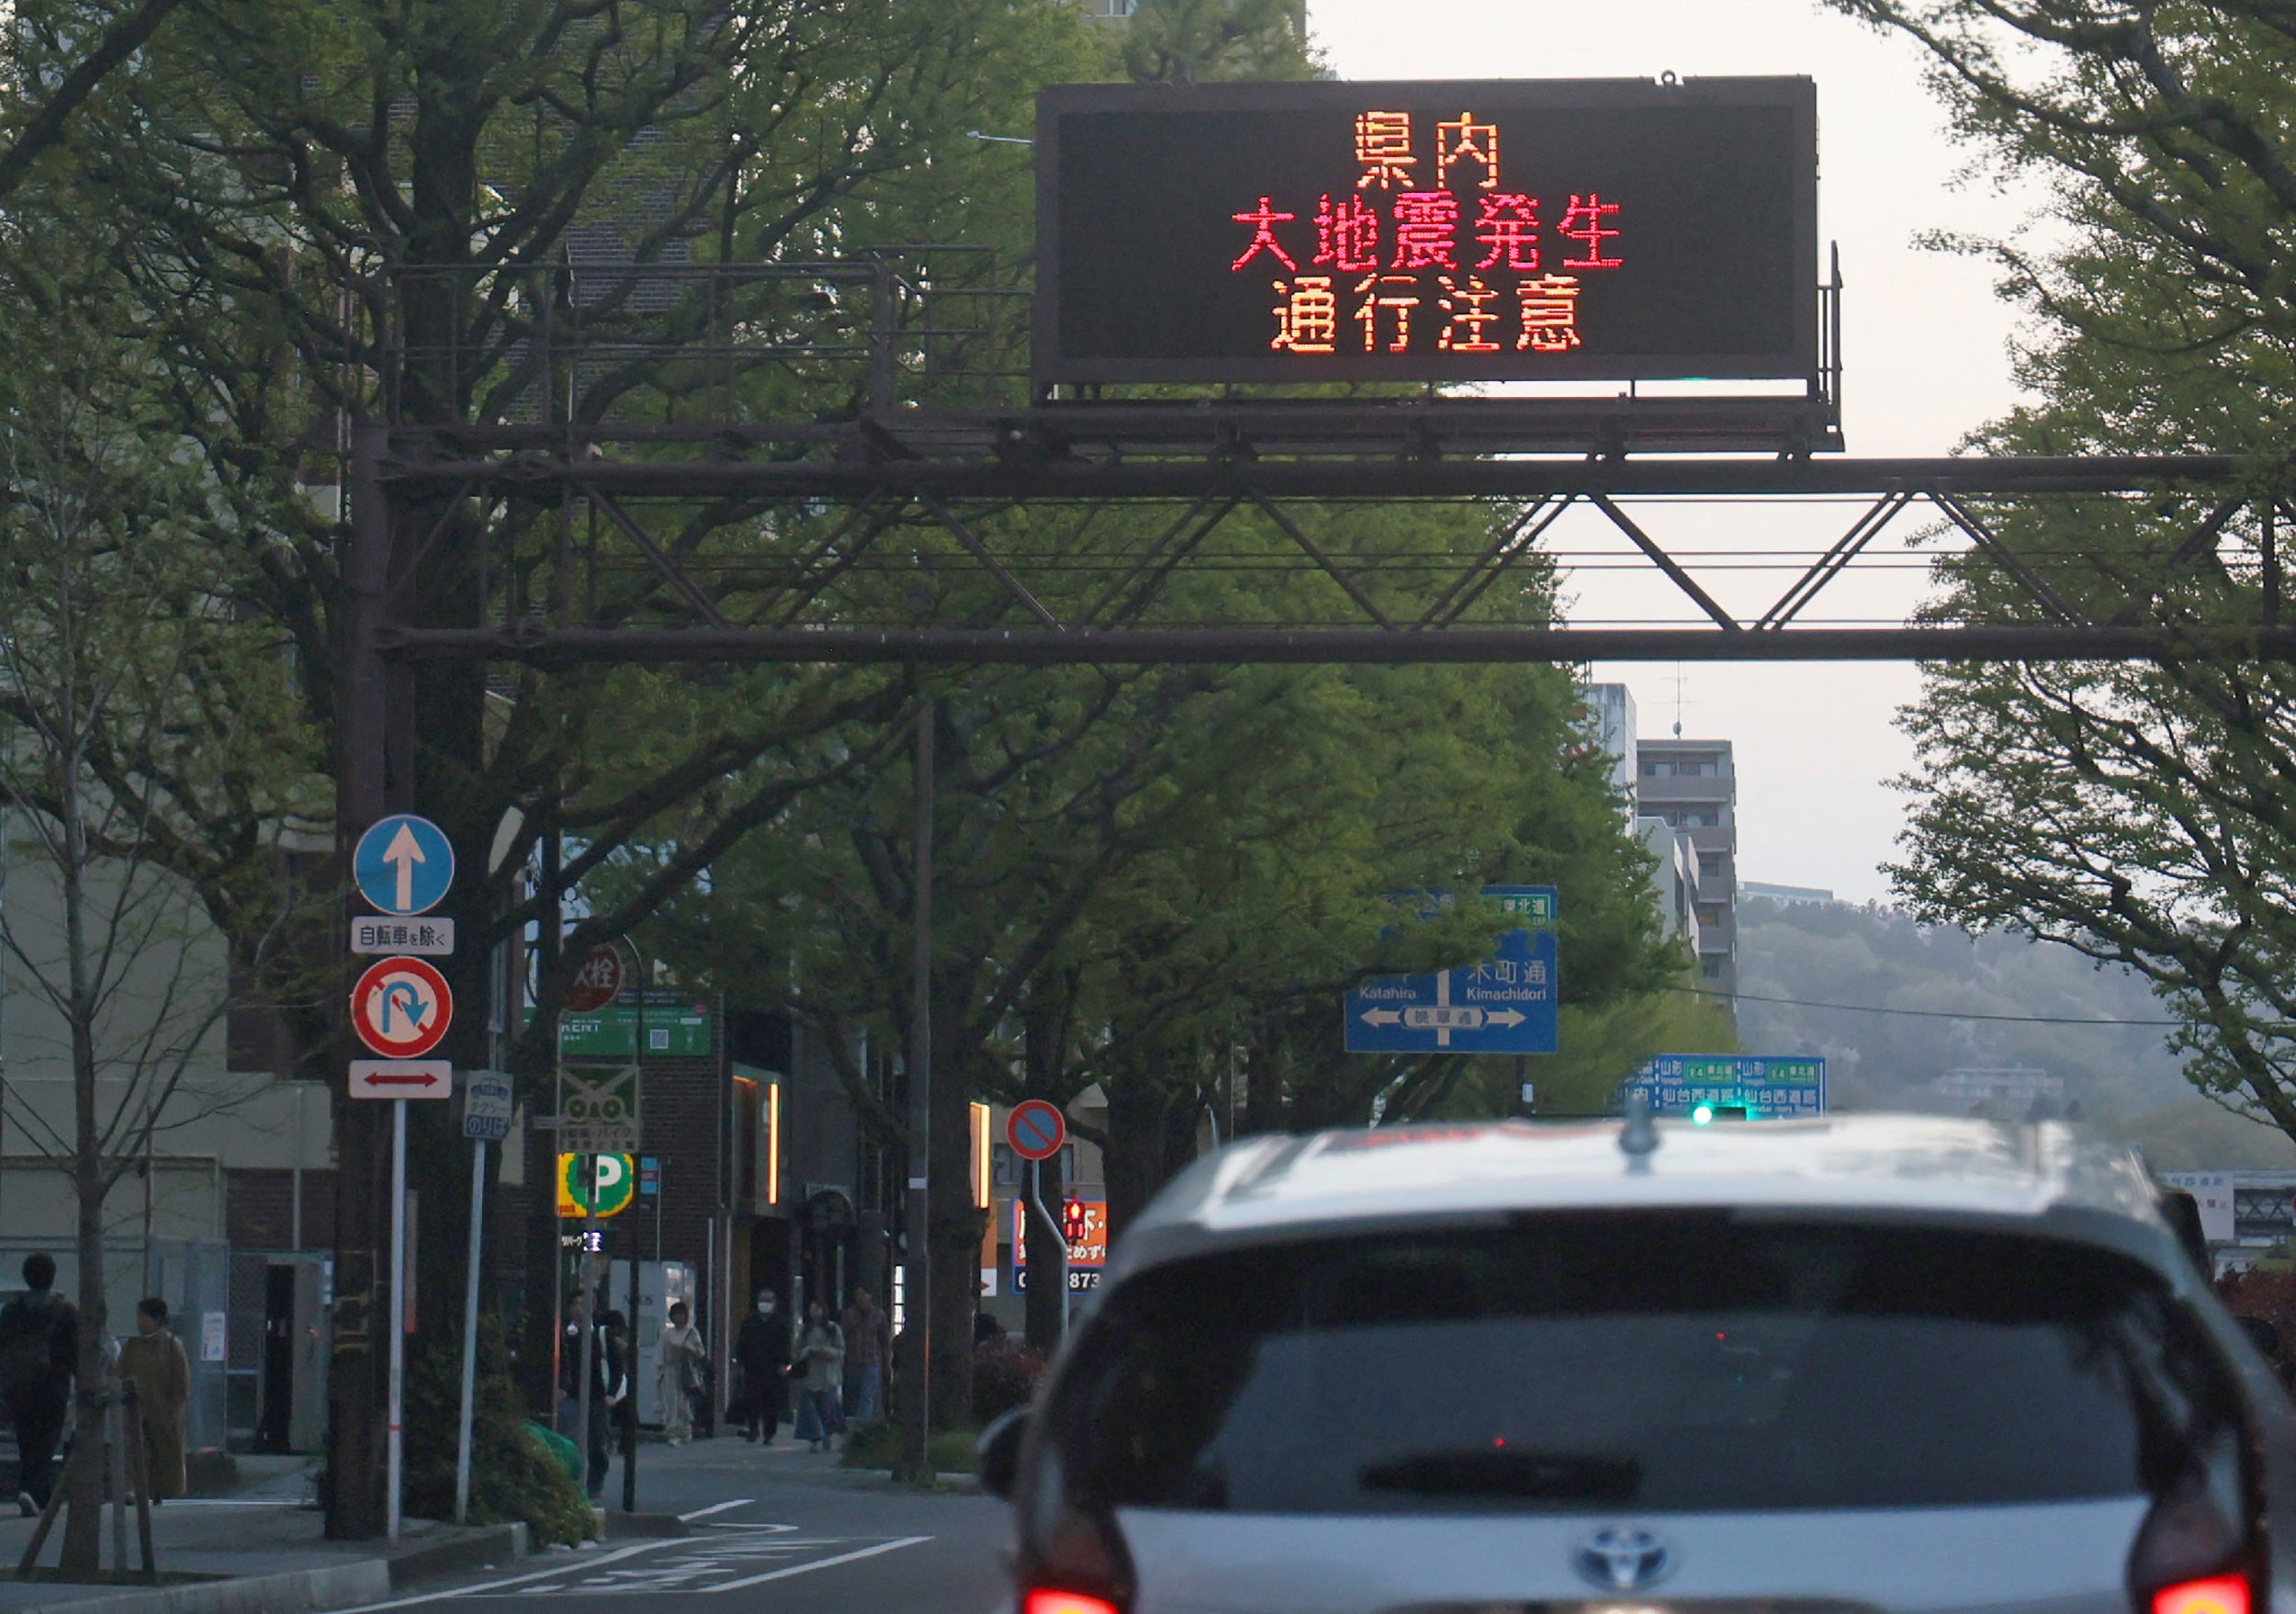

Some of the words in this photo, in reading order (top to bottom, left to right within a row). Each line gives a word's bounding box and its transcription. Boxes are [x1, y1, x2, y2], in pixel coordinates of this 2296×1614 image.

[1355, 110, 1500, 189] 県内
[1231, 190, 1625, 272] 大地震発生
[1271, 272, 1582, 353] 通行注意
[359, 924, 445, 947] 自転車を除く
[573, 957, 614, 988] 火栓
[1360, 987, 1416, 999] Katahira
[1467, 987, 1547, 1002] Kimachidori
[587, 1155, 622, 1203] P
